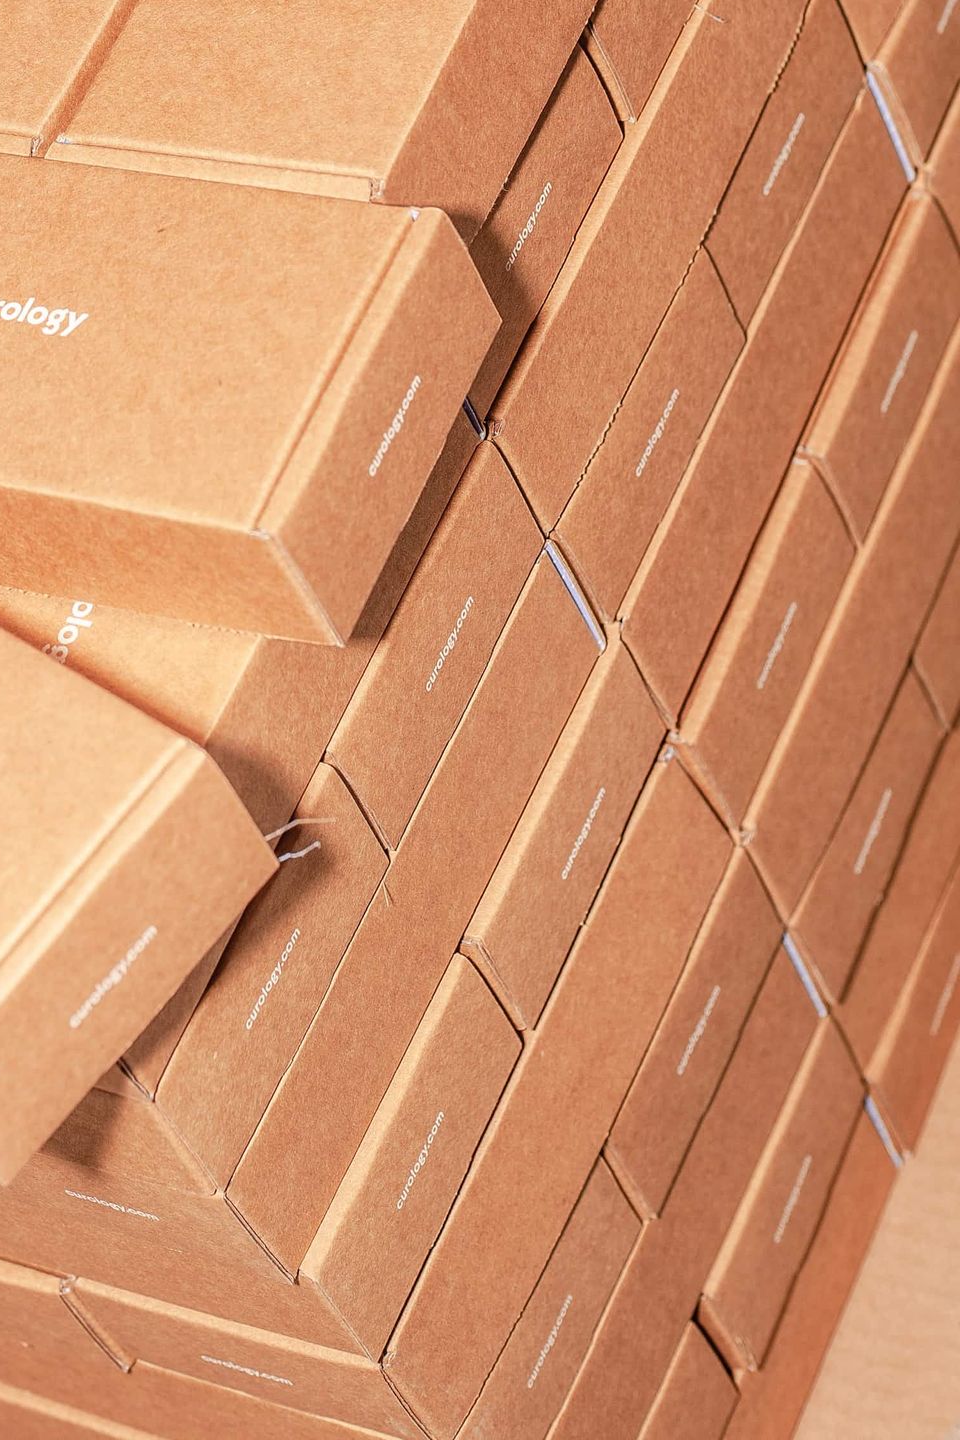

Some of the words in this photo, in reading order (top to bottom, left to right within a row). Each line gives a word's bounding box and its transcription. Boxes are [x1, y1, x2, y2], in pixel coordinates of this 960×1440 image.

[506, 181, 553, 271] curology.com
[368, 375, 422, 477] curology.com
[635, 388, 680, 478] curology.com
[425, 595, 475, 692] curology.com
[560, 787, 606, 881] curology.com
[68, 925, 158, 1029] curology.com
[244, 928, 301, 1031] curology.com
[396, 1110, 445, 1210] curology.com
[527, 1295, 573, 1389] curology.com
